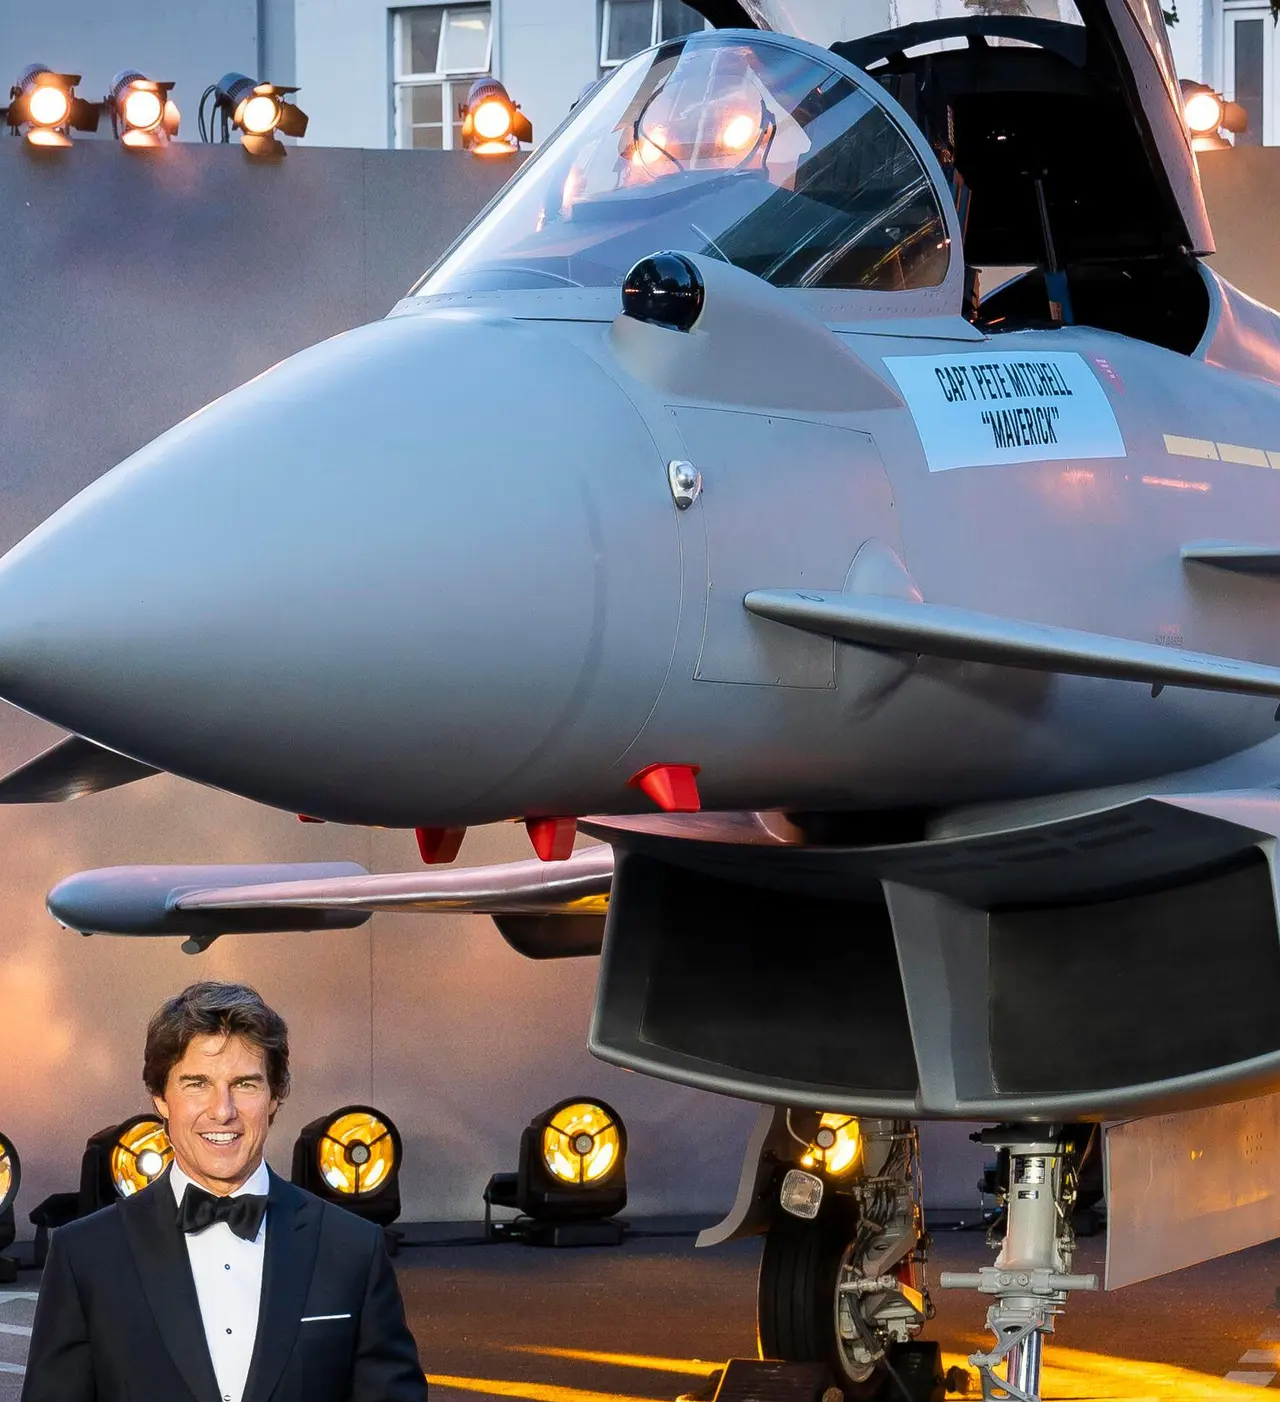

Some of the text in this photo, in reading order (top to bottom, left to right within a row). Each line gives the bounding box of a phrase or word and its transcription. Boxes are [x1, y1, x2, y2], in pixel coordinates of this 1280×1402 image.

[934, 365, 977, 402] CAPT
[970, 364, 1012, 400] PETE
[1003, 362, 1074, 398] MITCHELL
